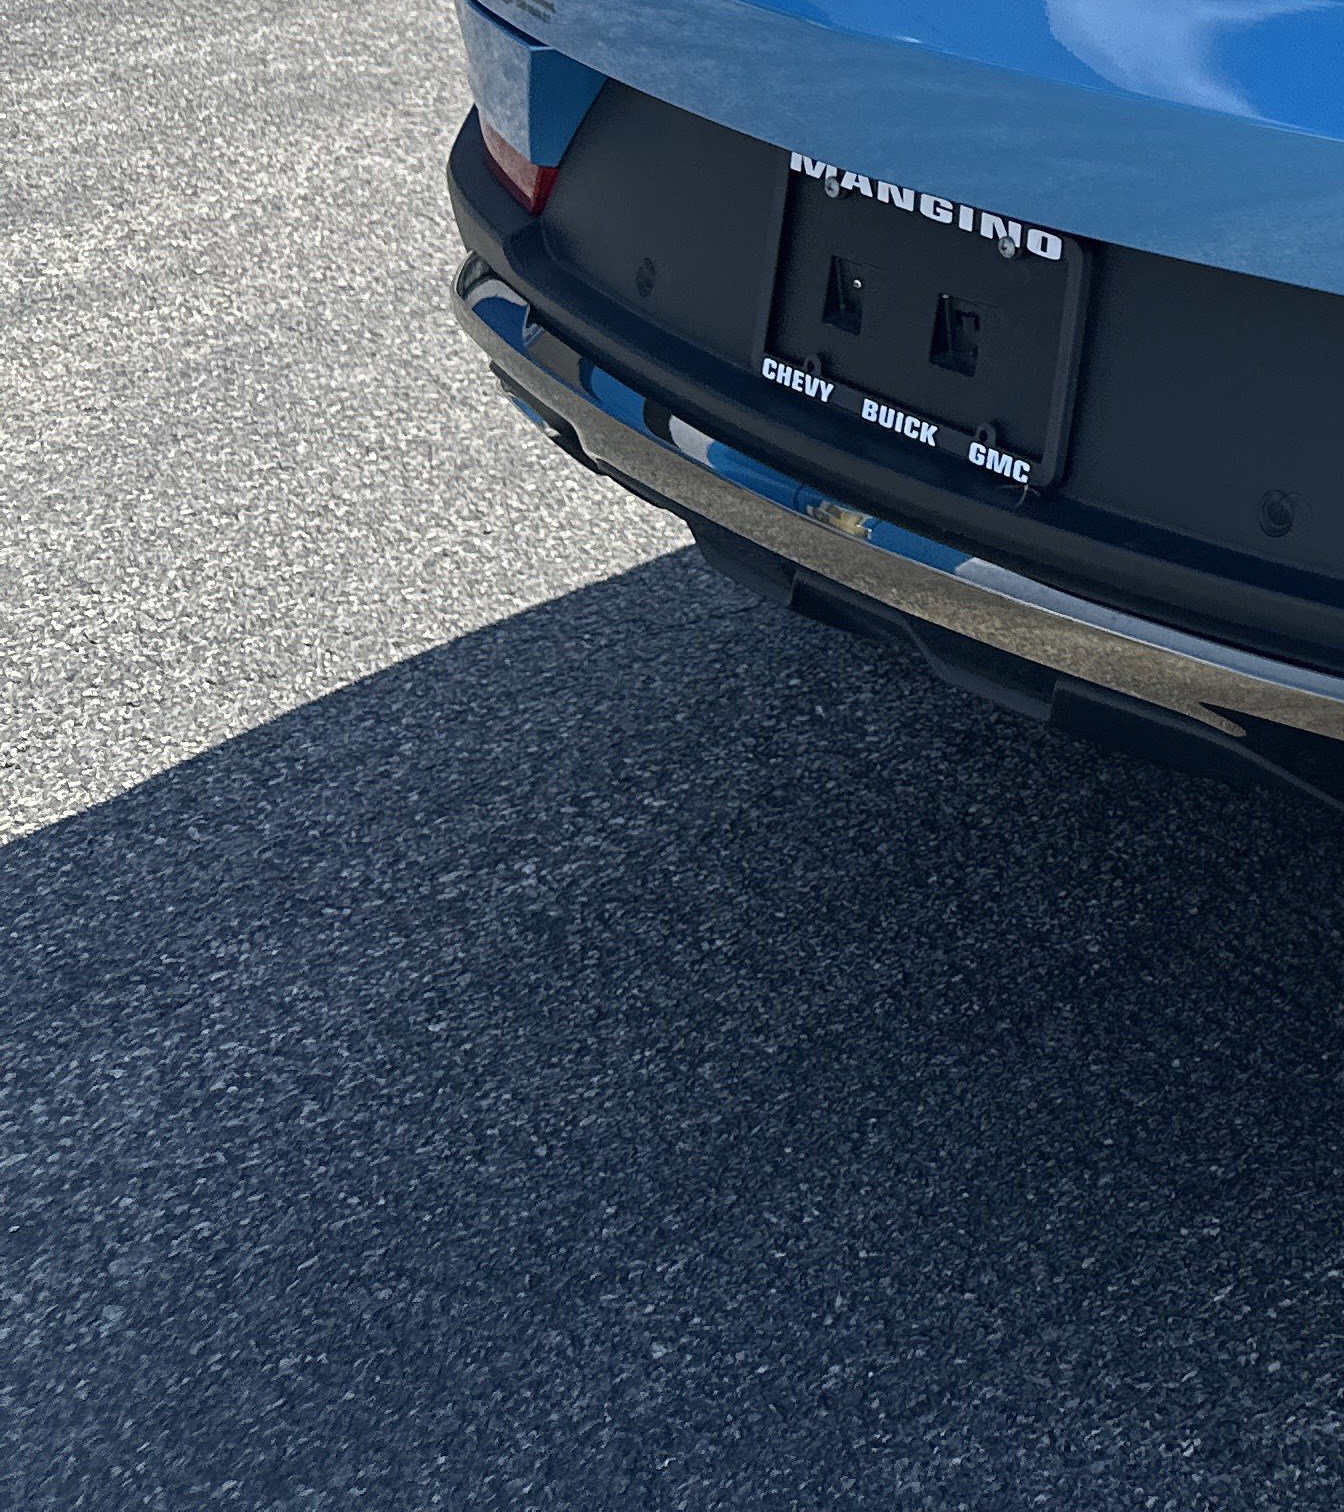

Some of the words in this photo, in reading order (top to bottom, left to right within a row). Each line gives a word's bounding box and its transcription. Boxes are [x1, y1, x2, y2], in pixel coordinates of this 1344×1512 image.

[790, 151, 1063, 261] MANGINO
[762, 357, 834, 403] CHEVY
[861, 398, 938, 447] BUICK
[968, 441, 1032, 484] GMC
